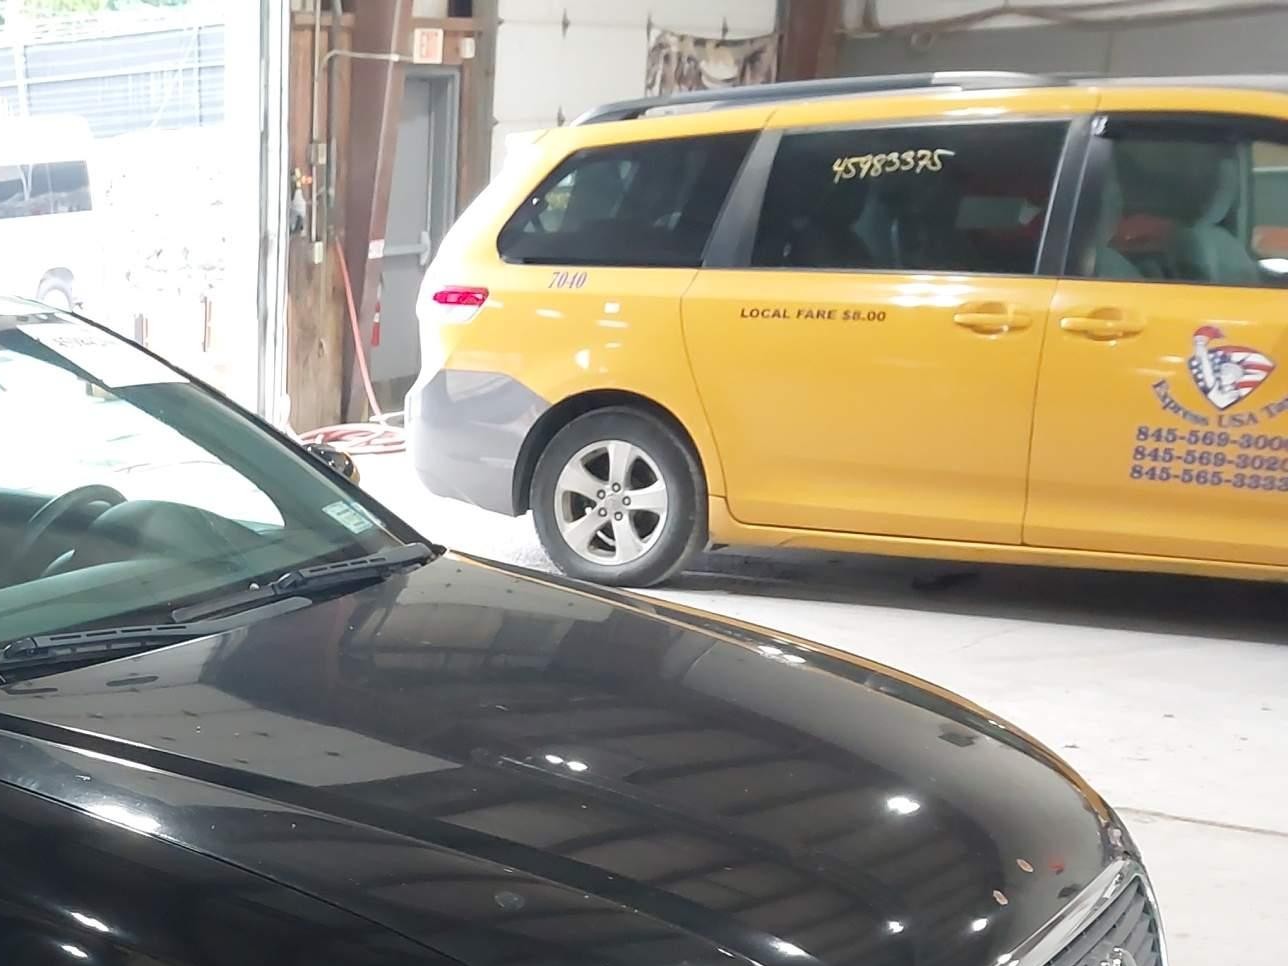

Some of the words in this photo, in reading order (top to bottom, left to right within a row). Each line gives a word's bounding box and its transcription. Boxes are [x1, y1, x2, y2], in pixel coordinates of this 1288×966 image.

[832, 148, 956, 184] 45983375
[548, 271, 588, 289] 7040
[740, 308, 790, 319] LOCAL
[796, 309, 838, 320] FARE
[1217, 412, 1259, 428] USA
